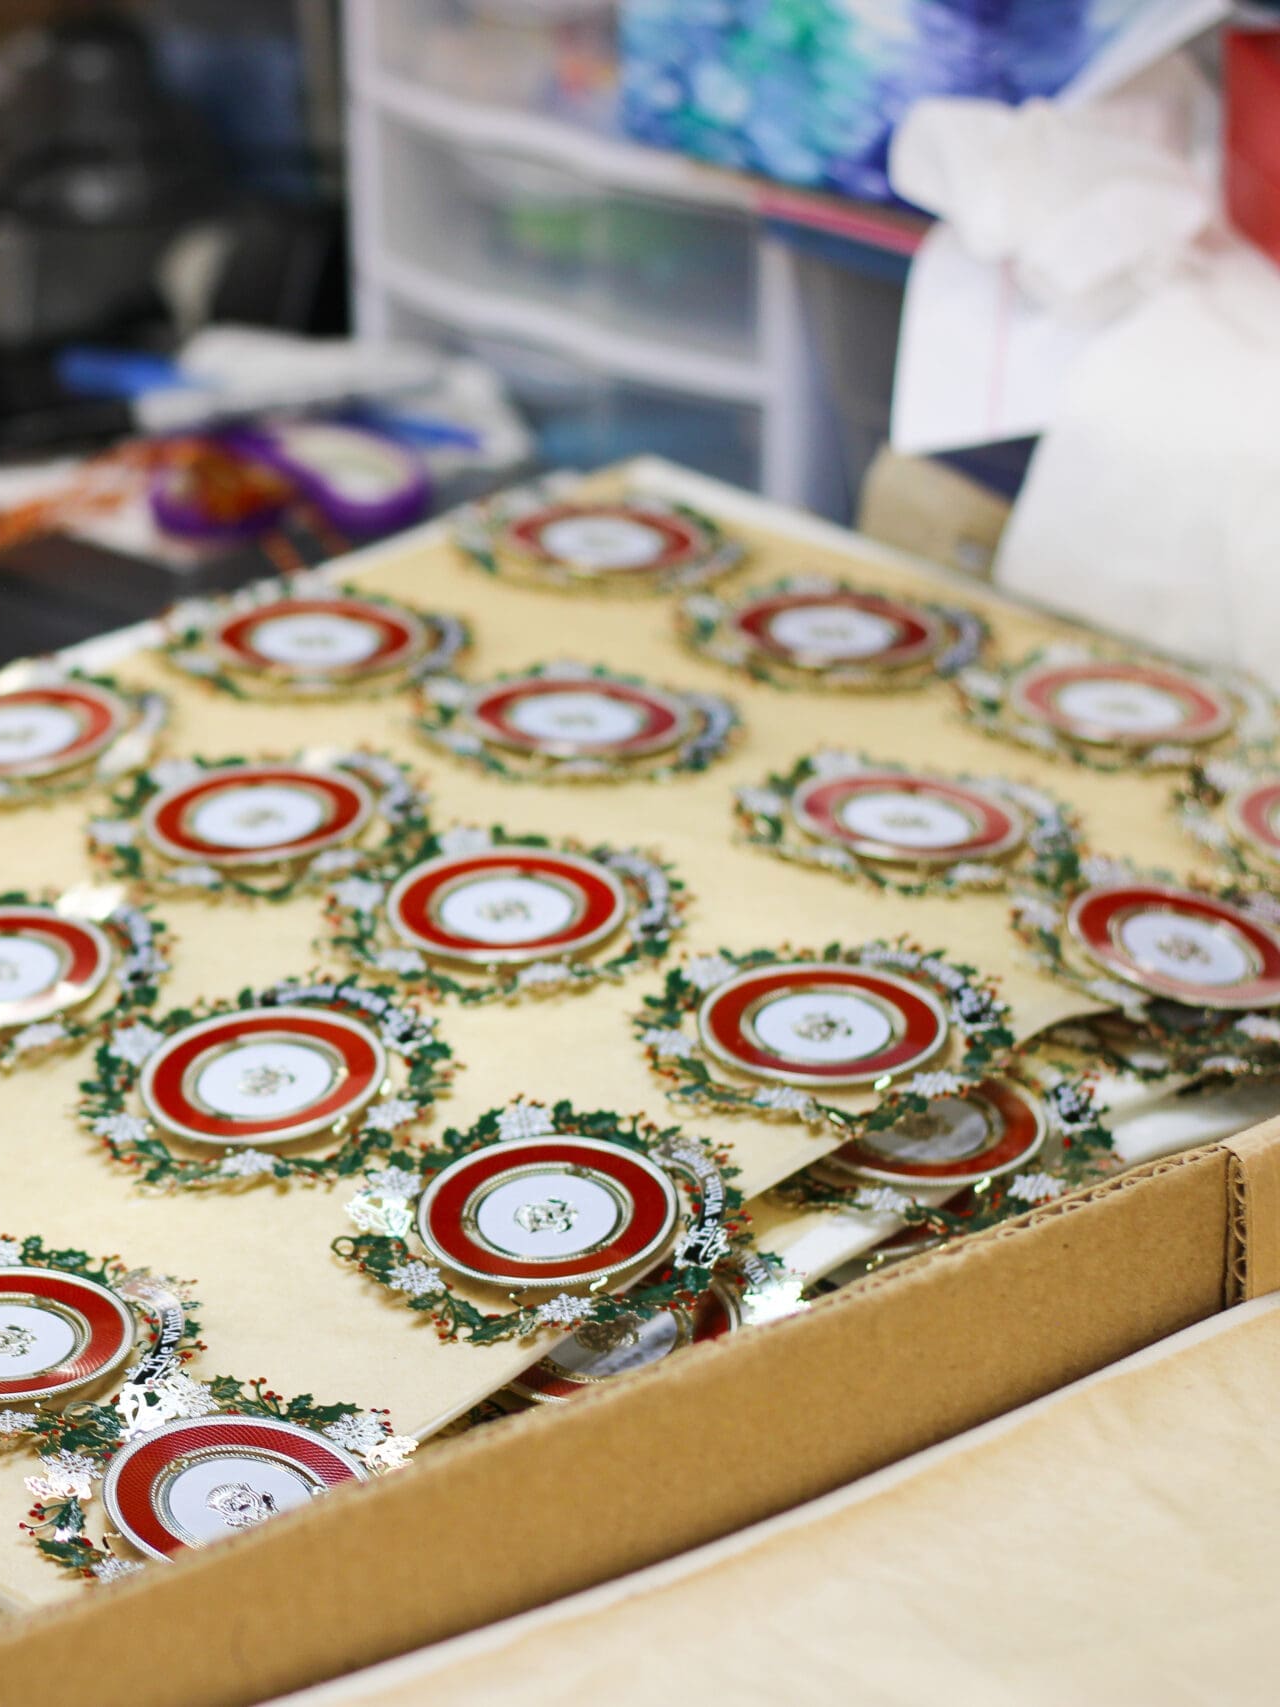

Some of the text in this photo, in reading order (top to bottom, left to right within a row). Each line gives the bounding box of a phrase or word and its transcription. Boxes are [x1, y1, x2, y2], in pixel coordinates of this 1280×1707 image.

[686, 1218, 718, 1246] The
[145, 1308, 183, 1373] The White
